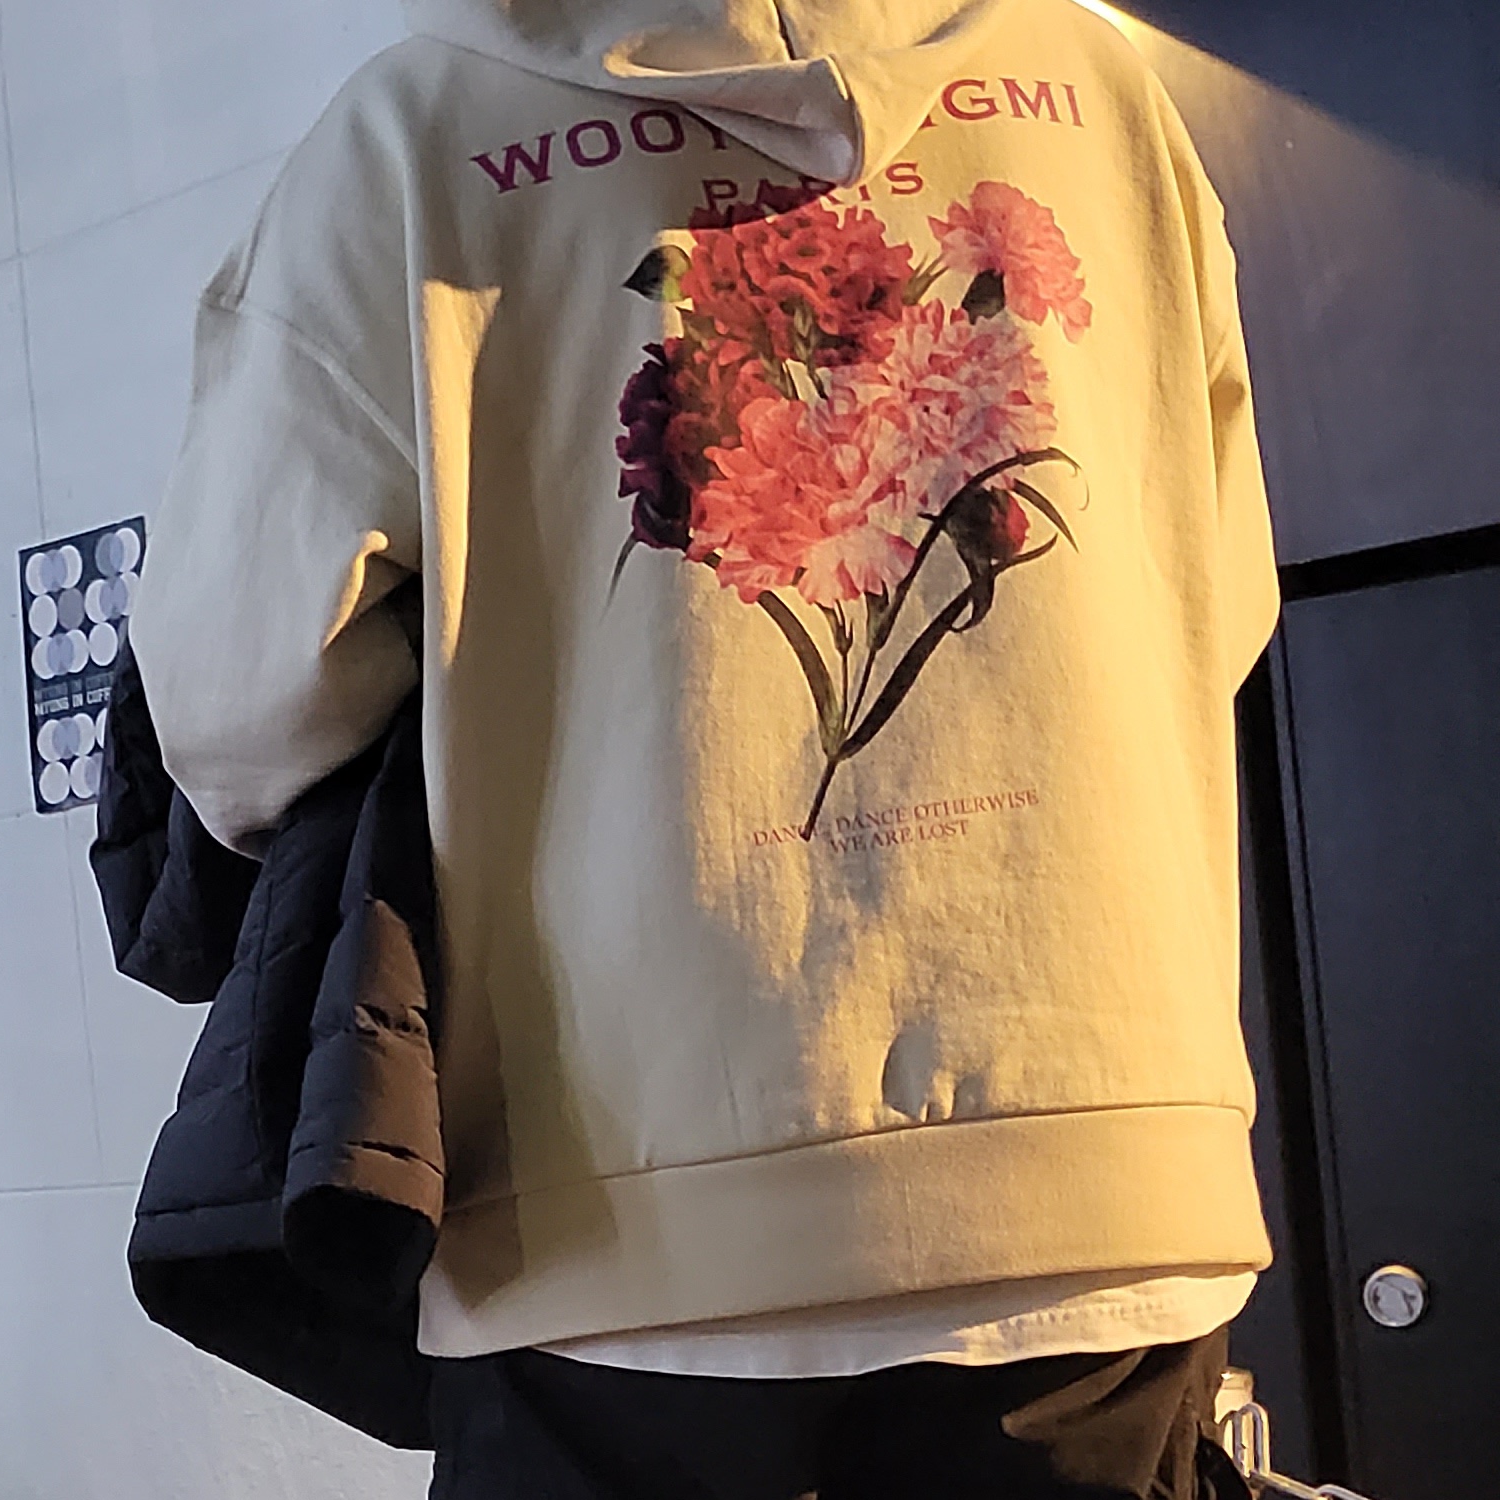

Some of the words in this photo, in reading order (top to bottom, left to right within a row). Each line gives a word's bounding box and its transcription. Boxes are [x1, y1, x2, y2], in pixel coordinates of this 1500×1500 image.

[835, 807, 908, 834] DANCE
[913, 789, 1039, 821] OTHERWISE
[830, 836, 867, 854] WE
[870, 827, 913, 852] ARE
[918, 819, 969, 841] LOST
